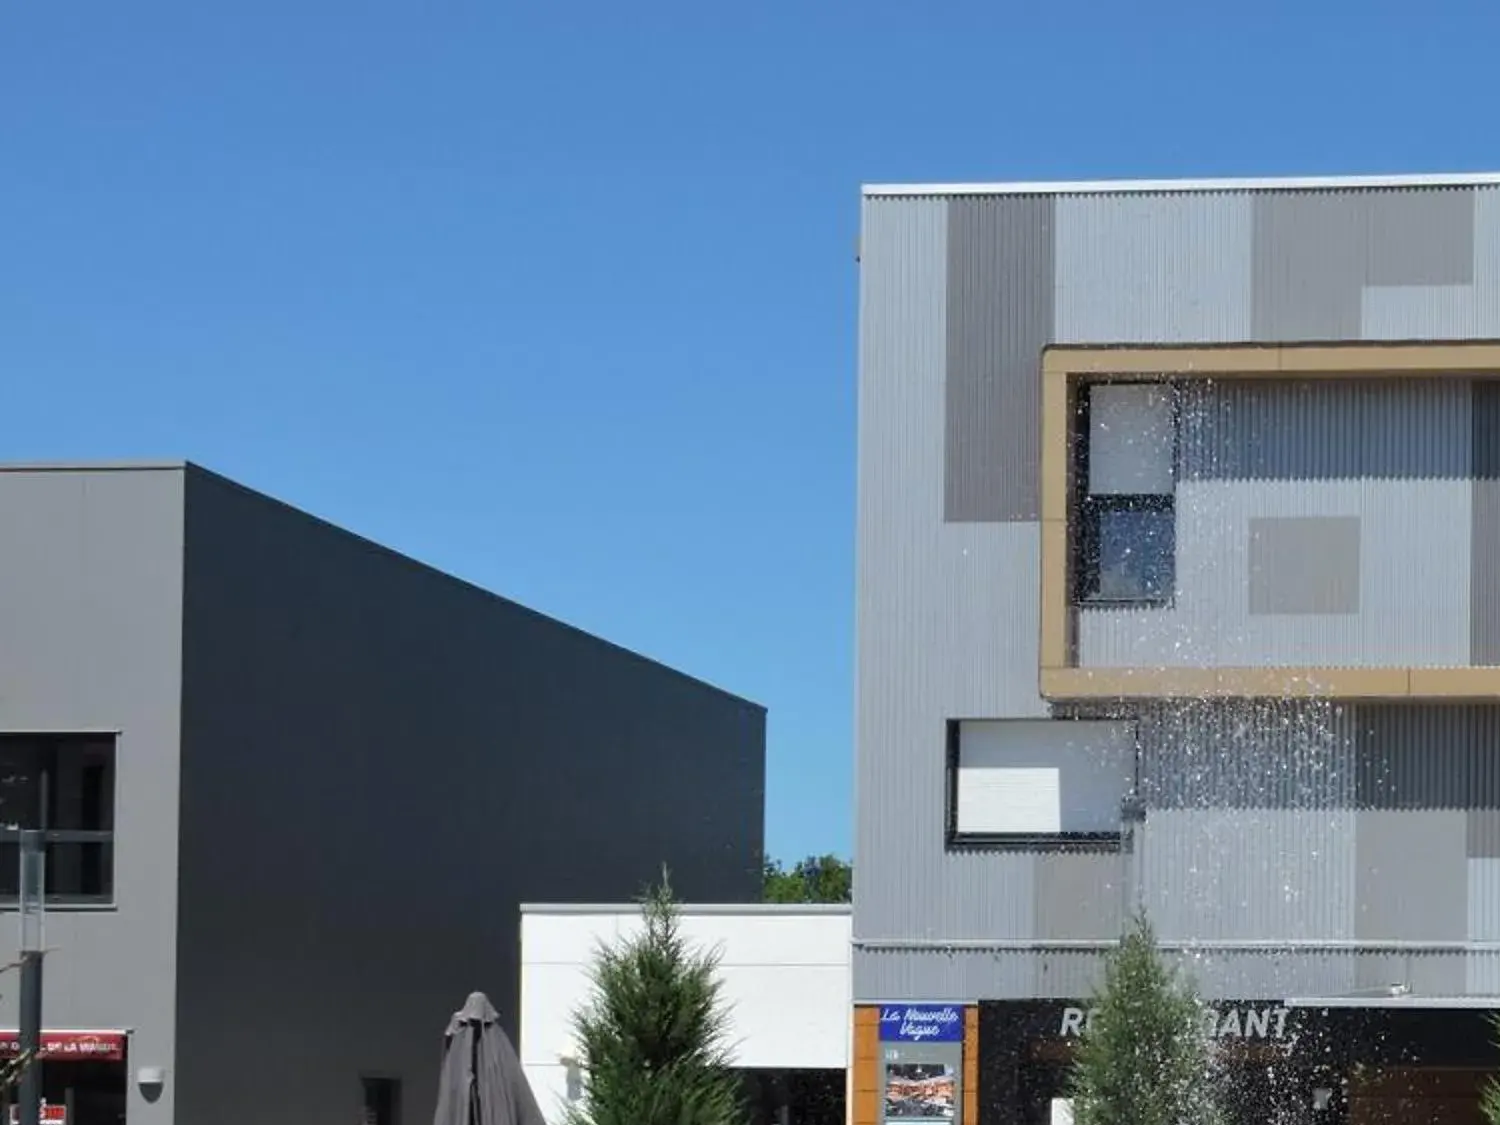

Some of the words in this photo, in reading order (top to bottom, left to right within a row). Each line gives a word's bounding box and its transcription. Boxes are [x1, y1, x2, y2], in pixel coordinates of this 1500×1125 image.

[880, 1008, 901, 1021] La
[903, 1007, 959, 1022] Nouvelle
[900, 1021, 940, 1041] Vague
